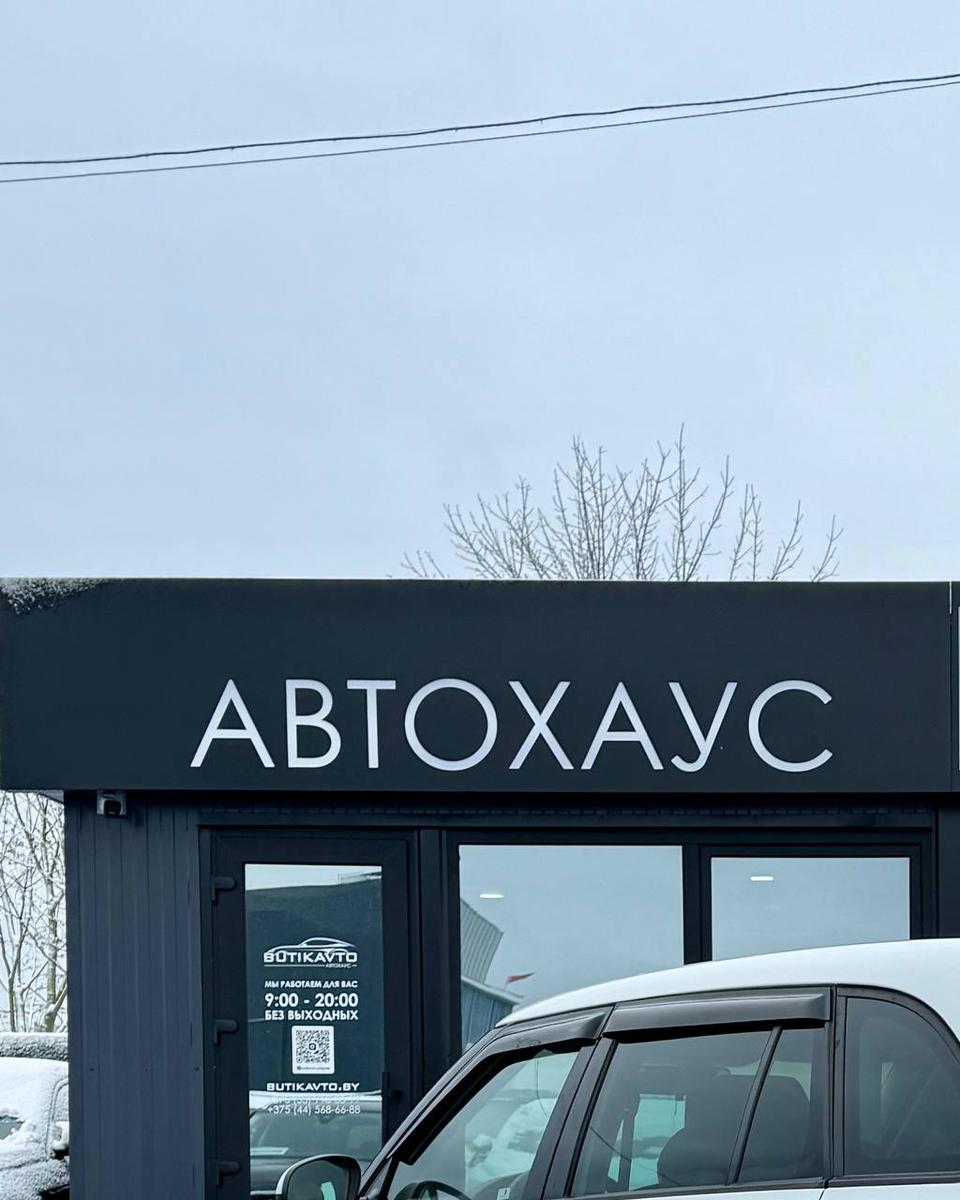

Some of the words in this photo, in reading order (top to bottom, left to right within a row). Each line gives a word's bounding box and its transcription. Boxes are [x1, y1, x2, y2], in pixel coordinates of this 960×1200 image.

[190, 678, 834, 774] АВТОХАУС
[263, 951, 358, 963] BUTIKAVTO
[264, 980, 279, 988] МЫ
[280, 980, 322, 988] РАБОТАЕМ
[322, 980, 340, 988] ДЛЯ
[341, 980, 358, 988] ВАС
[264, 993, 298, 1007] 9:00
[315, 993, 358, 1007] 20:00
[264, 1010, 284, 1021] БЕЗ
[287, 1010, 358, 1021] ВЫХОДНЫХ
[266, 1082, 360, 1091] BUTIKAVTO.BY
[267, 1105, 291, 1114] +375
[293, 1105, 311, 1116] (44)
[314, 1105, 360, 1114] 568-66-88
